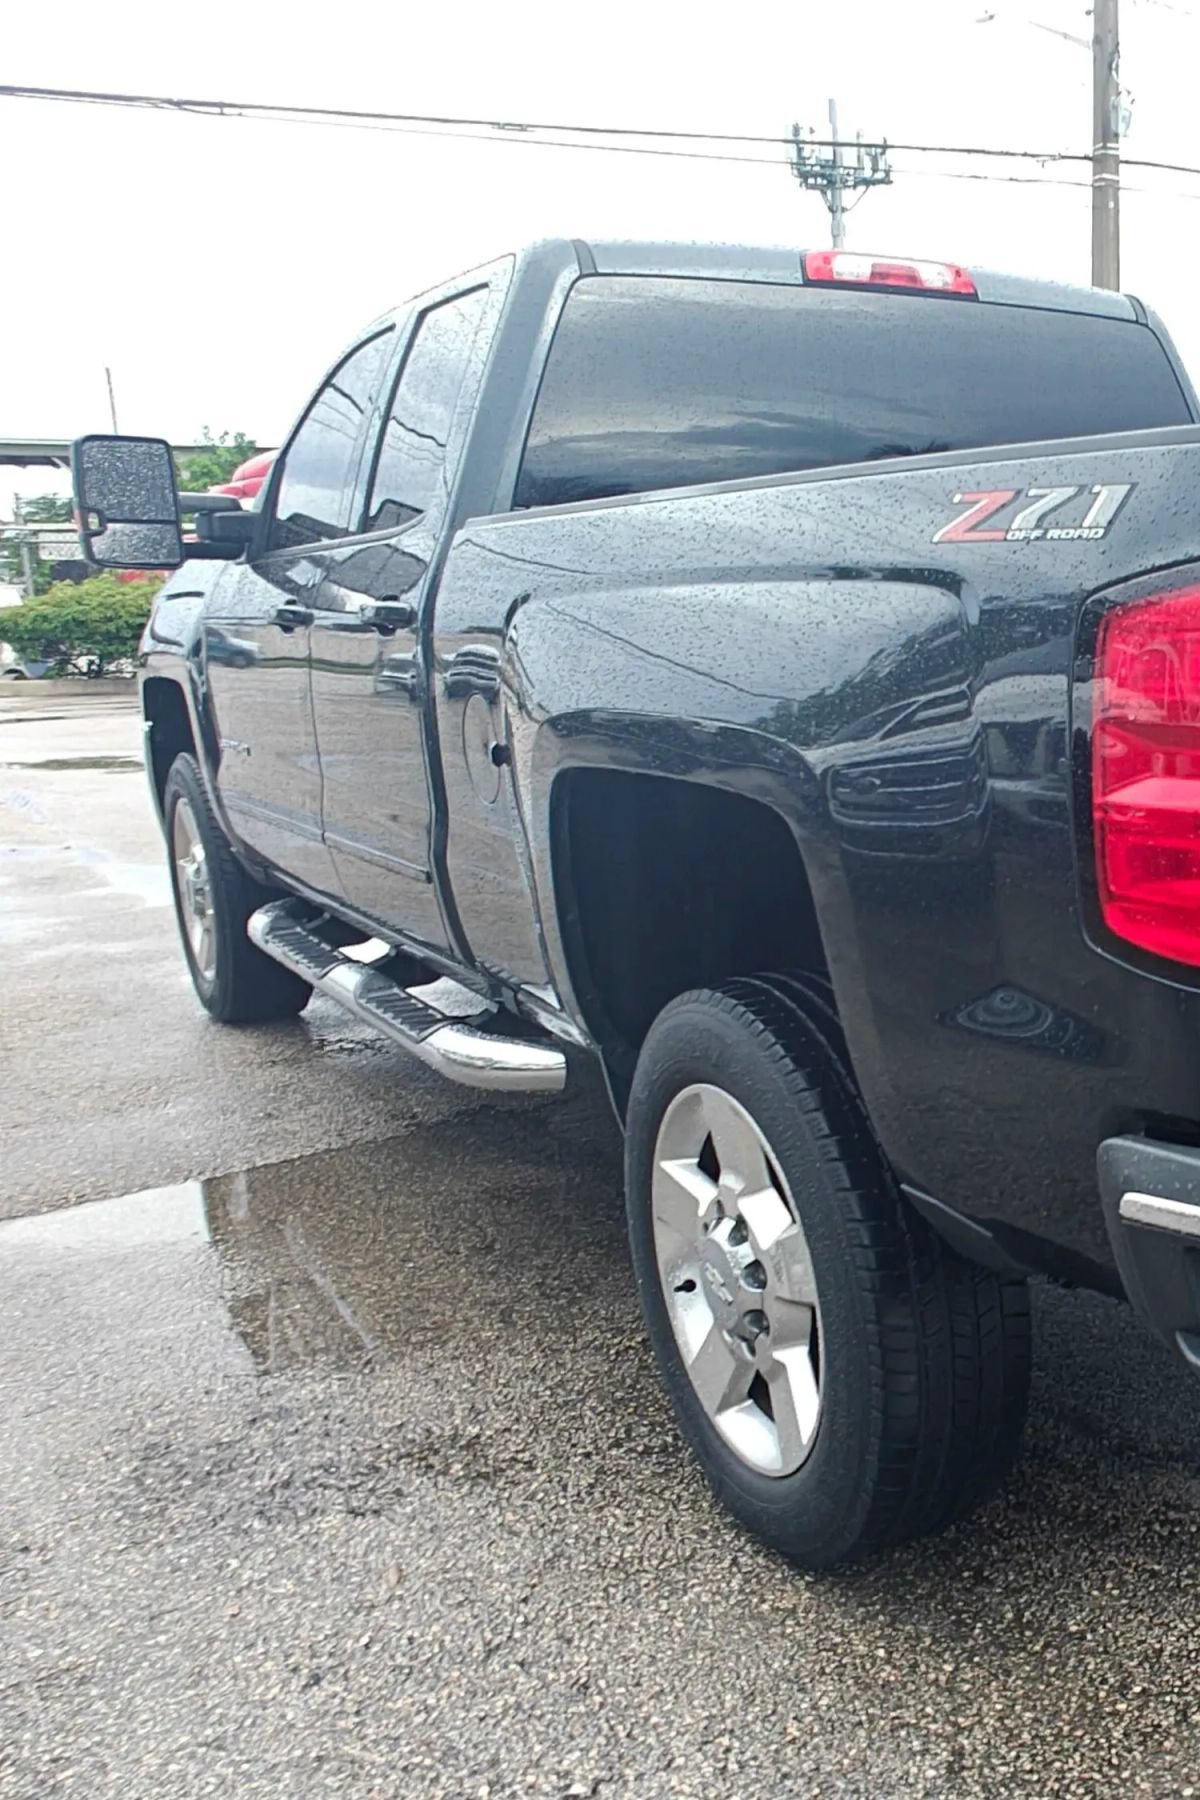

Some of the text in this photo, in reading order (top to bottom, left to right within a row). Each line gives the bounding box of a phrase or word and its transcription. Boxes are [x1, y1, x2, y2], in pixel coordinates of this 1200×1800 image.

[932, 482, 1139, 543] Z71
[1006, 527, 1105, 541] OFF ROAD
